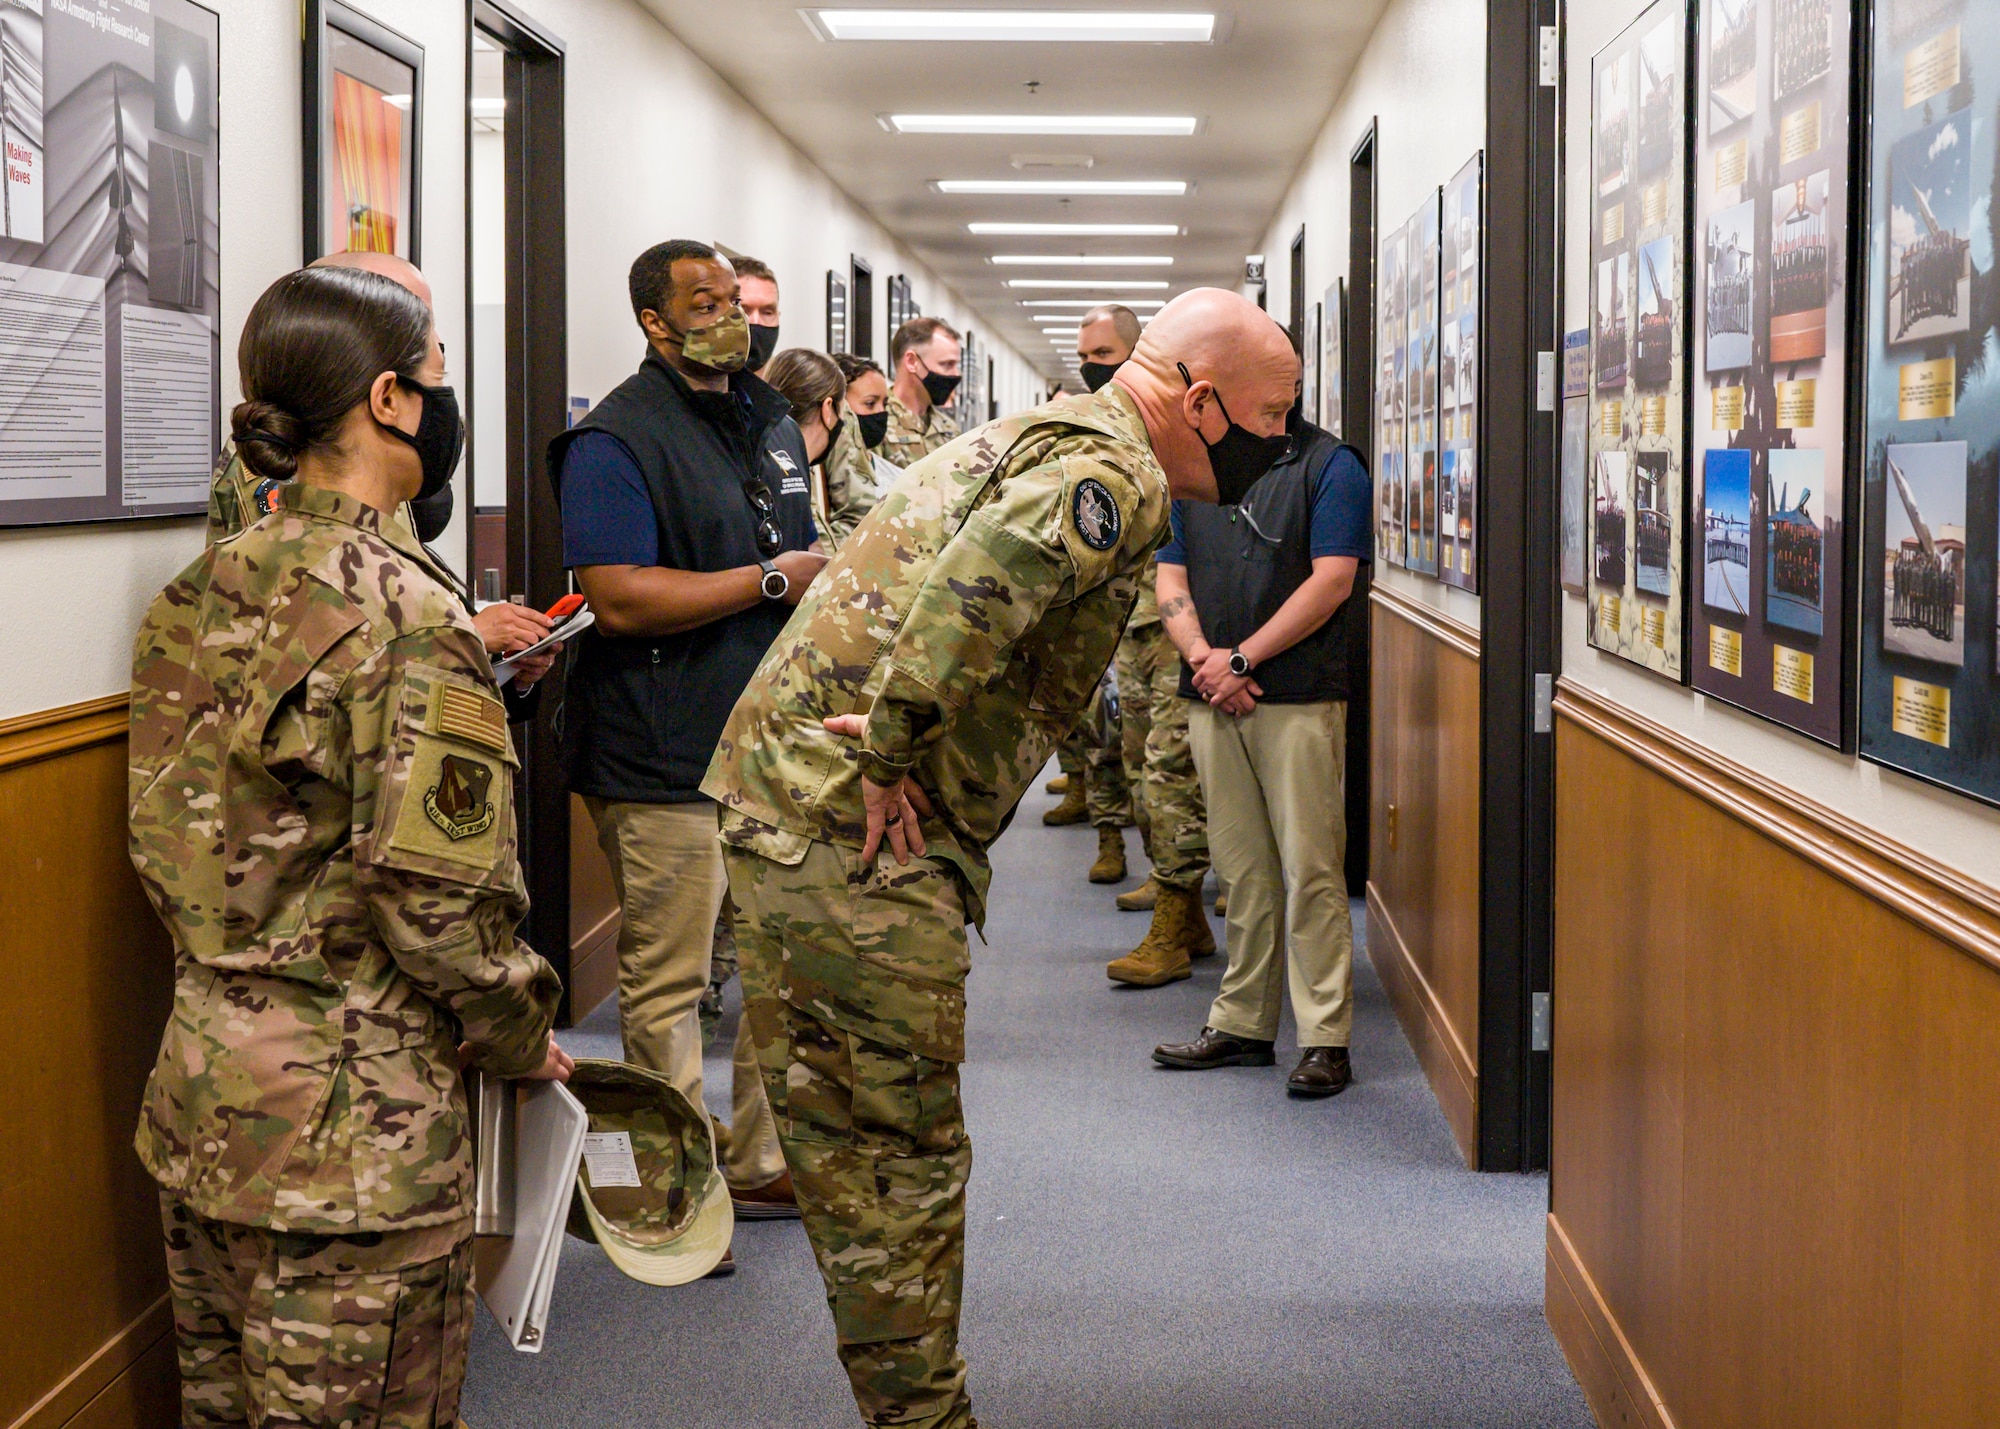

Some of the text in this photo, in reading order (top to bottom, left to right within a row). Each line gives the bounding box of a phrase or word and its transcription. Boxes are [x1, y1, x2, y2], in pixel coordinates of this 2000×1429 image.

[67, 0, 95, 29] Armstrong
[95, 9, 111, 33] Flight
[111, 16, 134, 41] Research
[134, 26, 150, 47] Center
[7, 142, 32, 167] Making
[9, 164, 30, 184] Waves
[446, 822, 466, 837] TEST
[466, 820, 487, 832] WING
